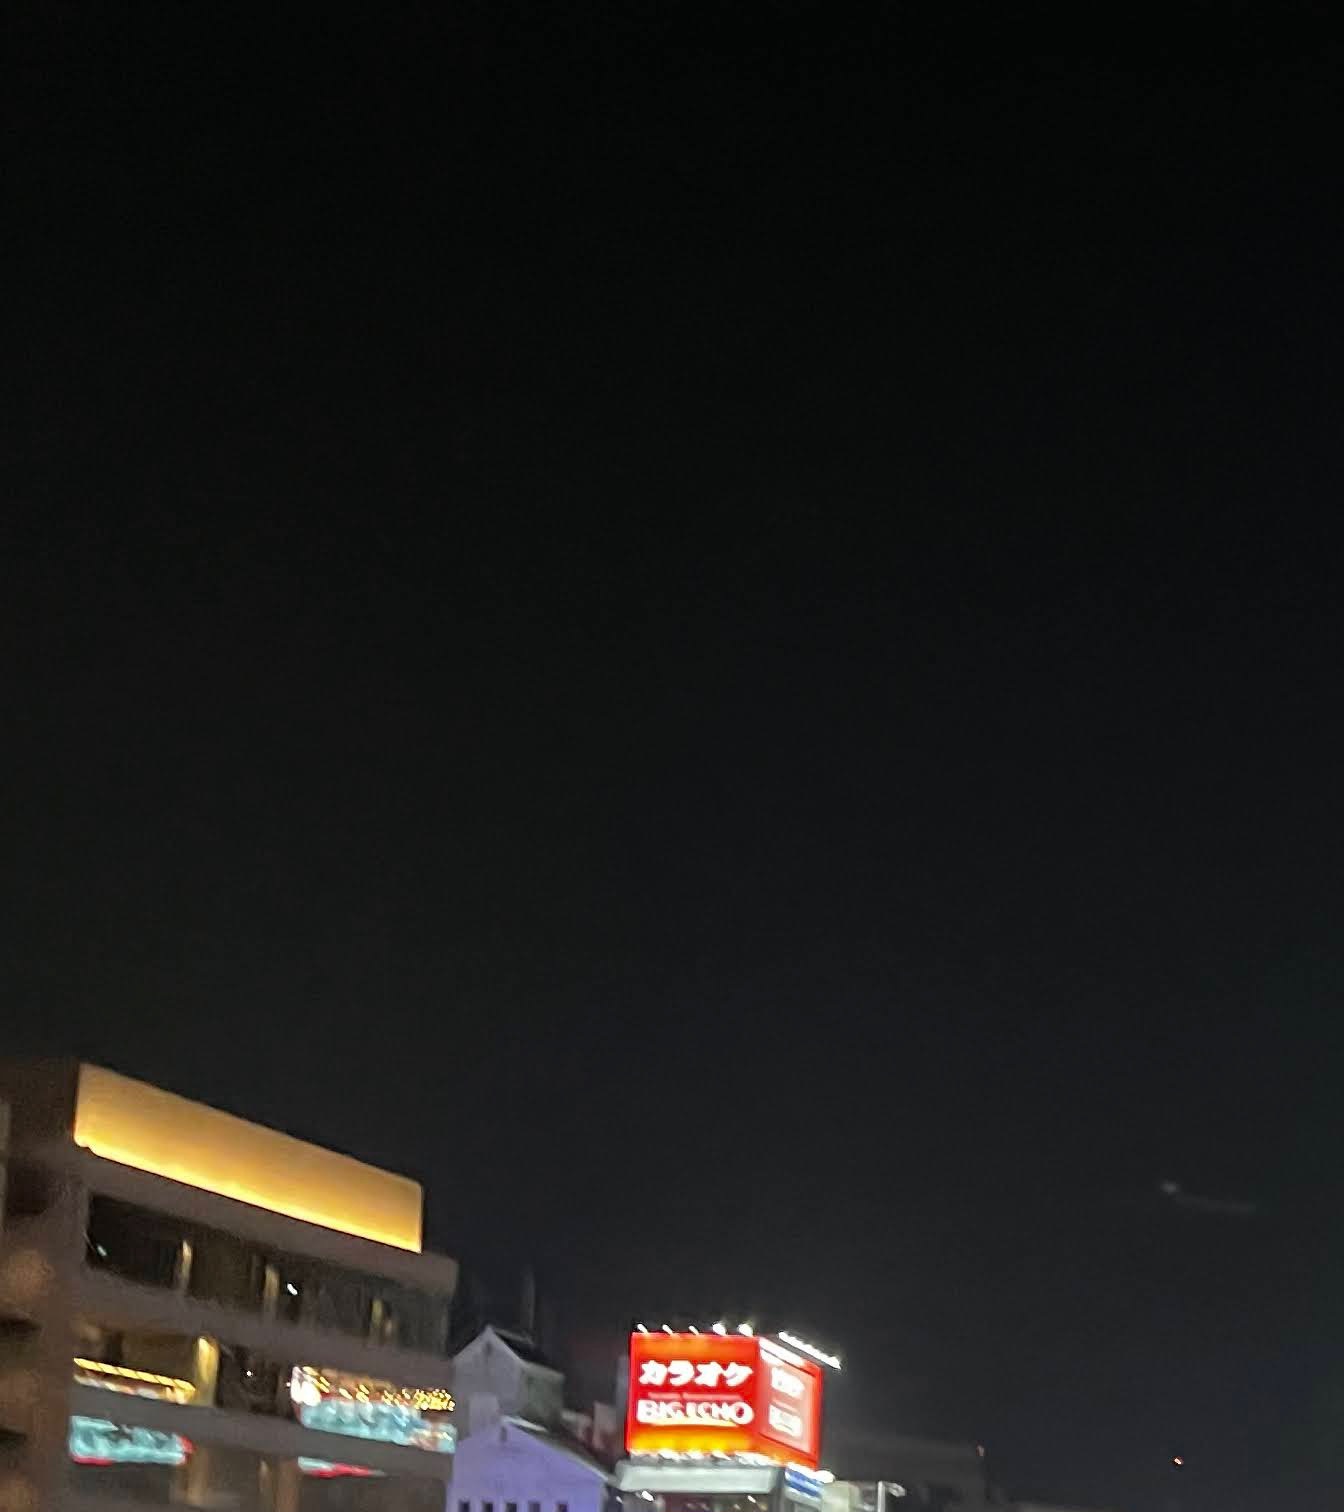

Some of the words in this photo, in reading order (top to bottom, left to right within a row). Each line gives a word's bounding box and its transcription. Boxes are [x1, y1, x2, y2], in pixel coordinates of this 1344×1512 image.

[638, 1360, 753, 1387] カラオケ
[636, 1400, 684, 1424] BIG
